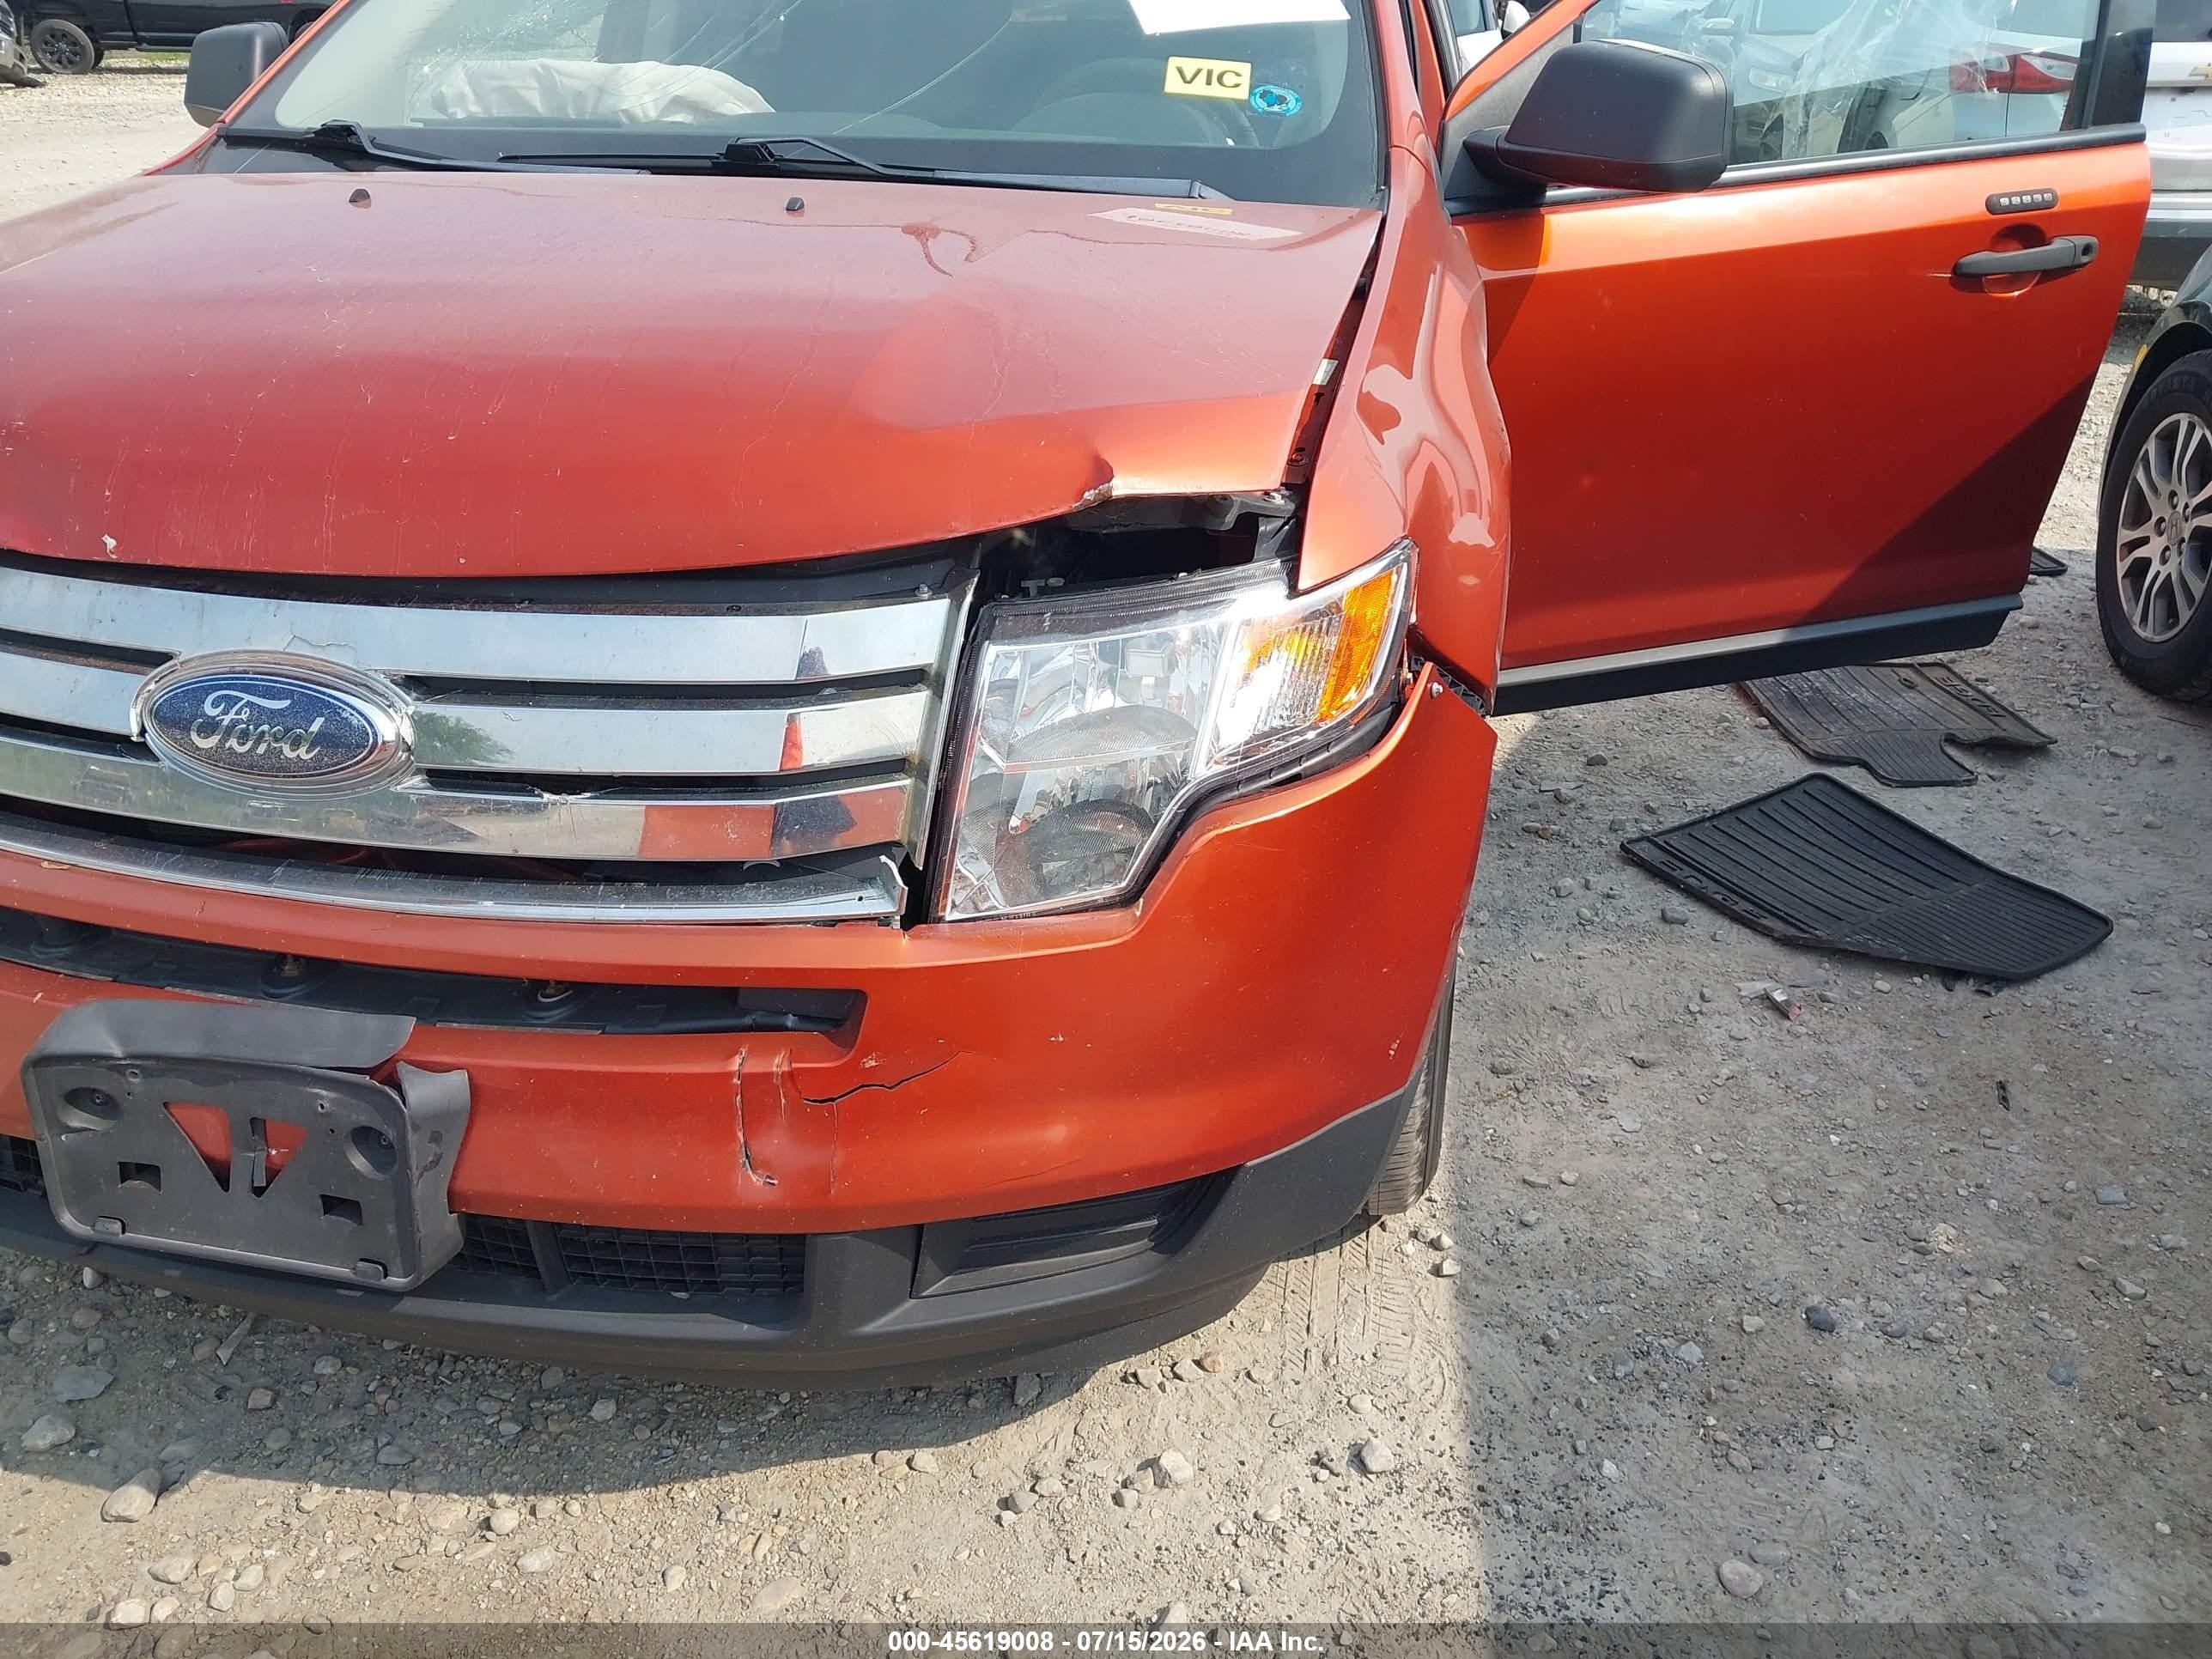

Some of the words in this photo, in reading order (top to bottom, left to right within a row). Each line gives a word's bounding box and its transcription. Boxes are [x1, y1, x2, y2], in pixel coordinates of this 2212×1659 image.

[1175, 66, 1243, 88] VIC
[1933, 677, 2007, 718] EDGE
[190, 690, 325, 760] Ford
[1658, 859, 1771, 920] EDGE
